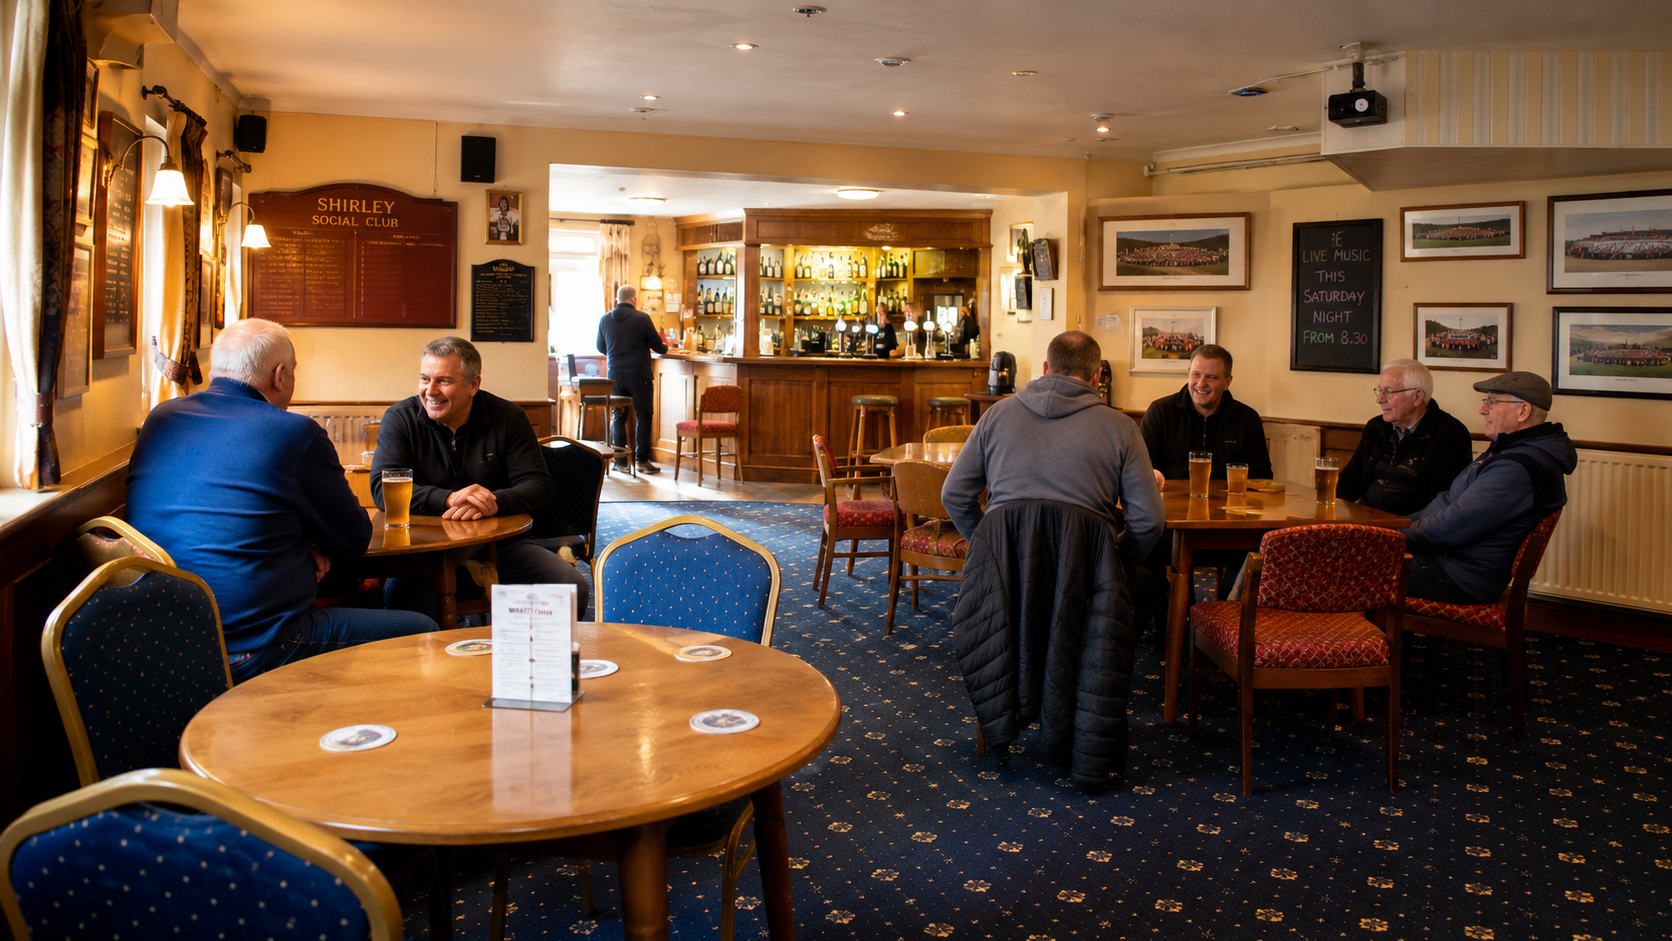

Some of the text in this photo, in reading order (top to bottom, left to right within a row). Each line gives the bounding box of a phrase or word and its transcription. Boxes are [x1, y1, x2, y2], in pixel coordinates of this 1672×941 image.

[317, 197, 396, 214] SHIRLEY
[312, 215, 399, 228] SOCIAL CLUB
[1302, 248, 1371, 263] LIVE MUSIC
[1314, 270, 1346, 283] THIS
[1303, 289, 1366, 306] SATURDAY
[1312, 310, 1352, 323] NIGHT
[1303, 330, 1368, 344] FROM 8.30
